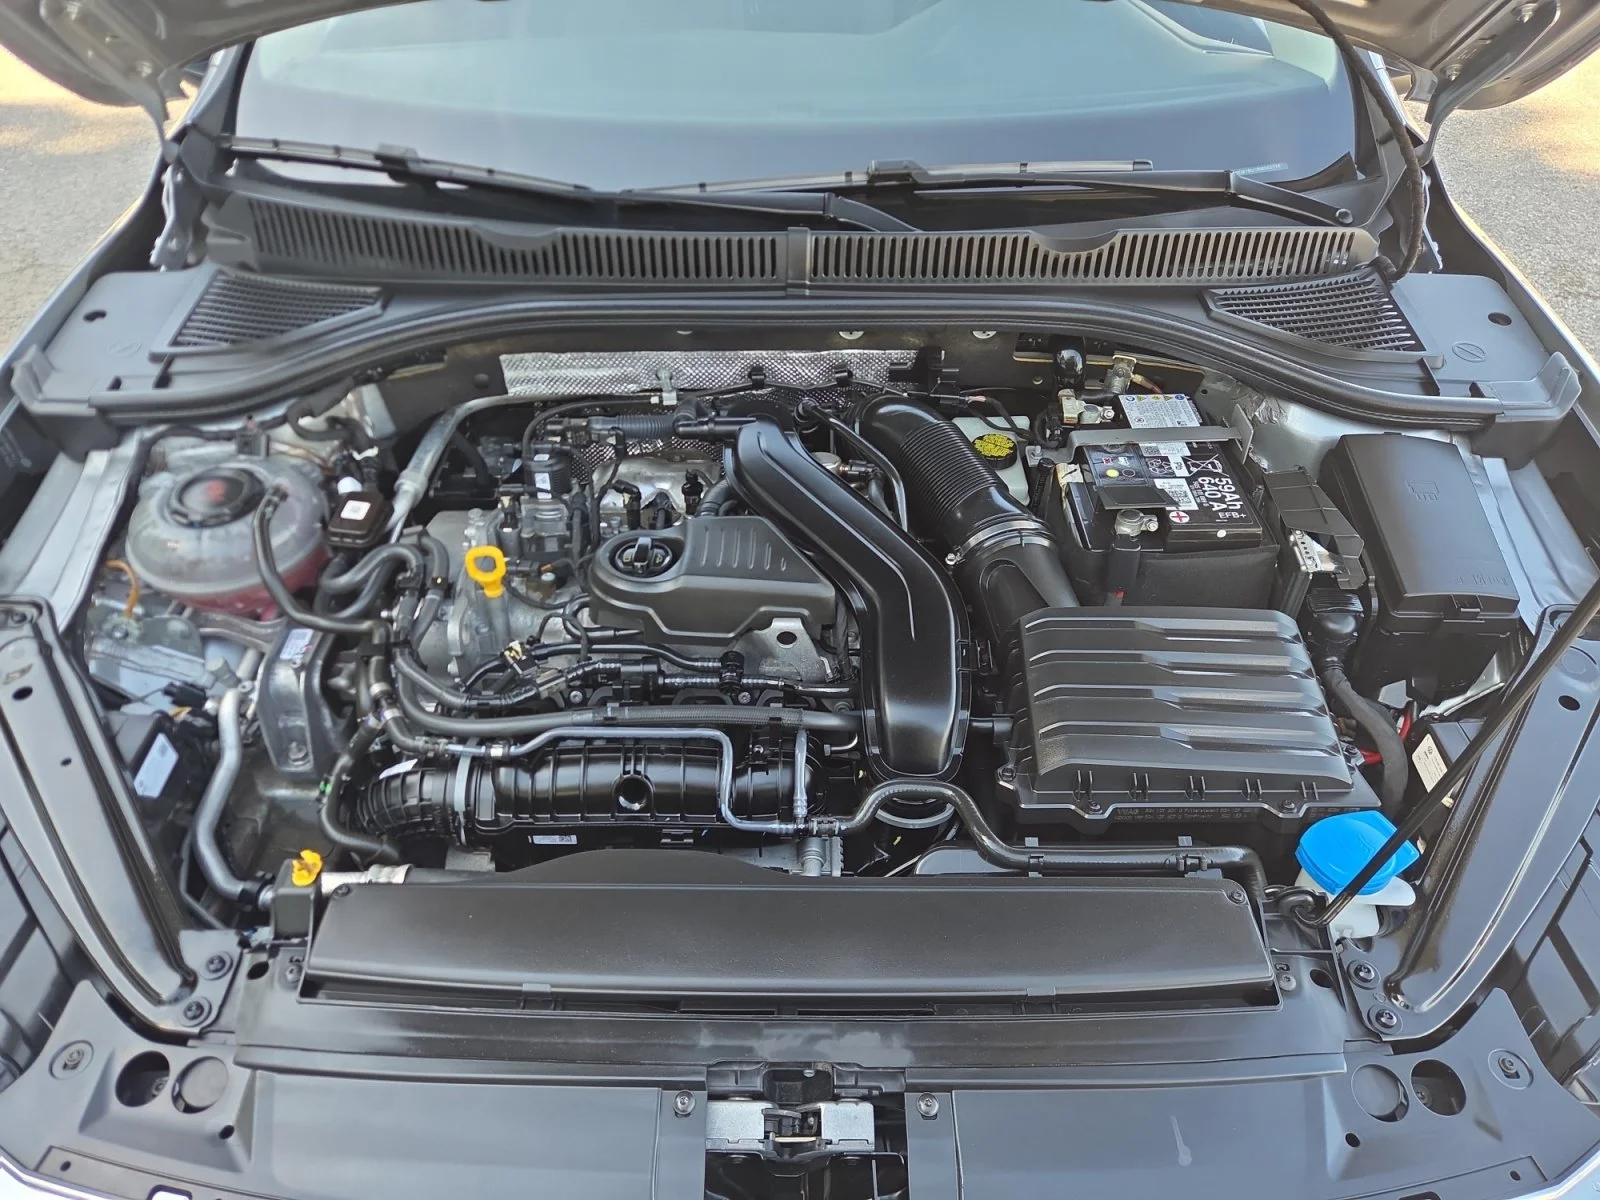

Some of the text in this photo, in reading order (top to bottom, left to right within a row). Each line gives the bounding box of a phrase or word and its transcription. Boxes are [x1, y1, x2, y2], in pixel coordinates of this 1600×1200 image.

[1174, 461, 1183, 471] Pb
[1198, 477, 1222, 498] 640
[1215, 478, 1243, 510] 59Ah
[1209, 501, 1228, 511] A
[1218, 511, 1247, 519] EFB+
